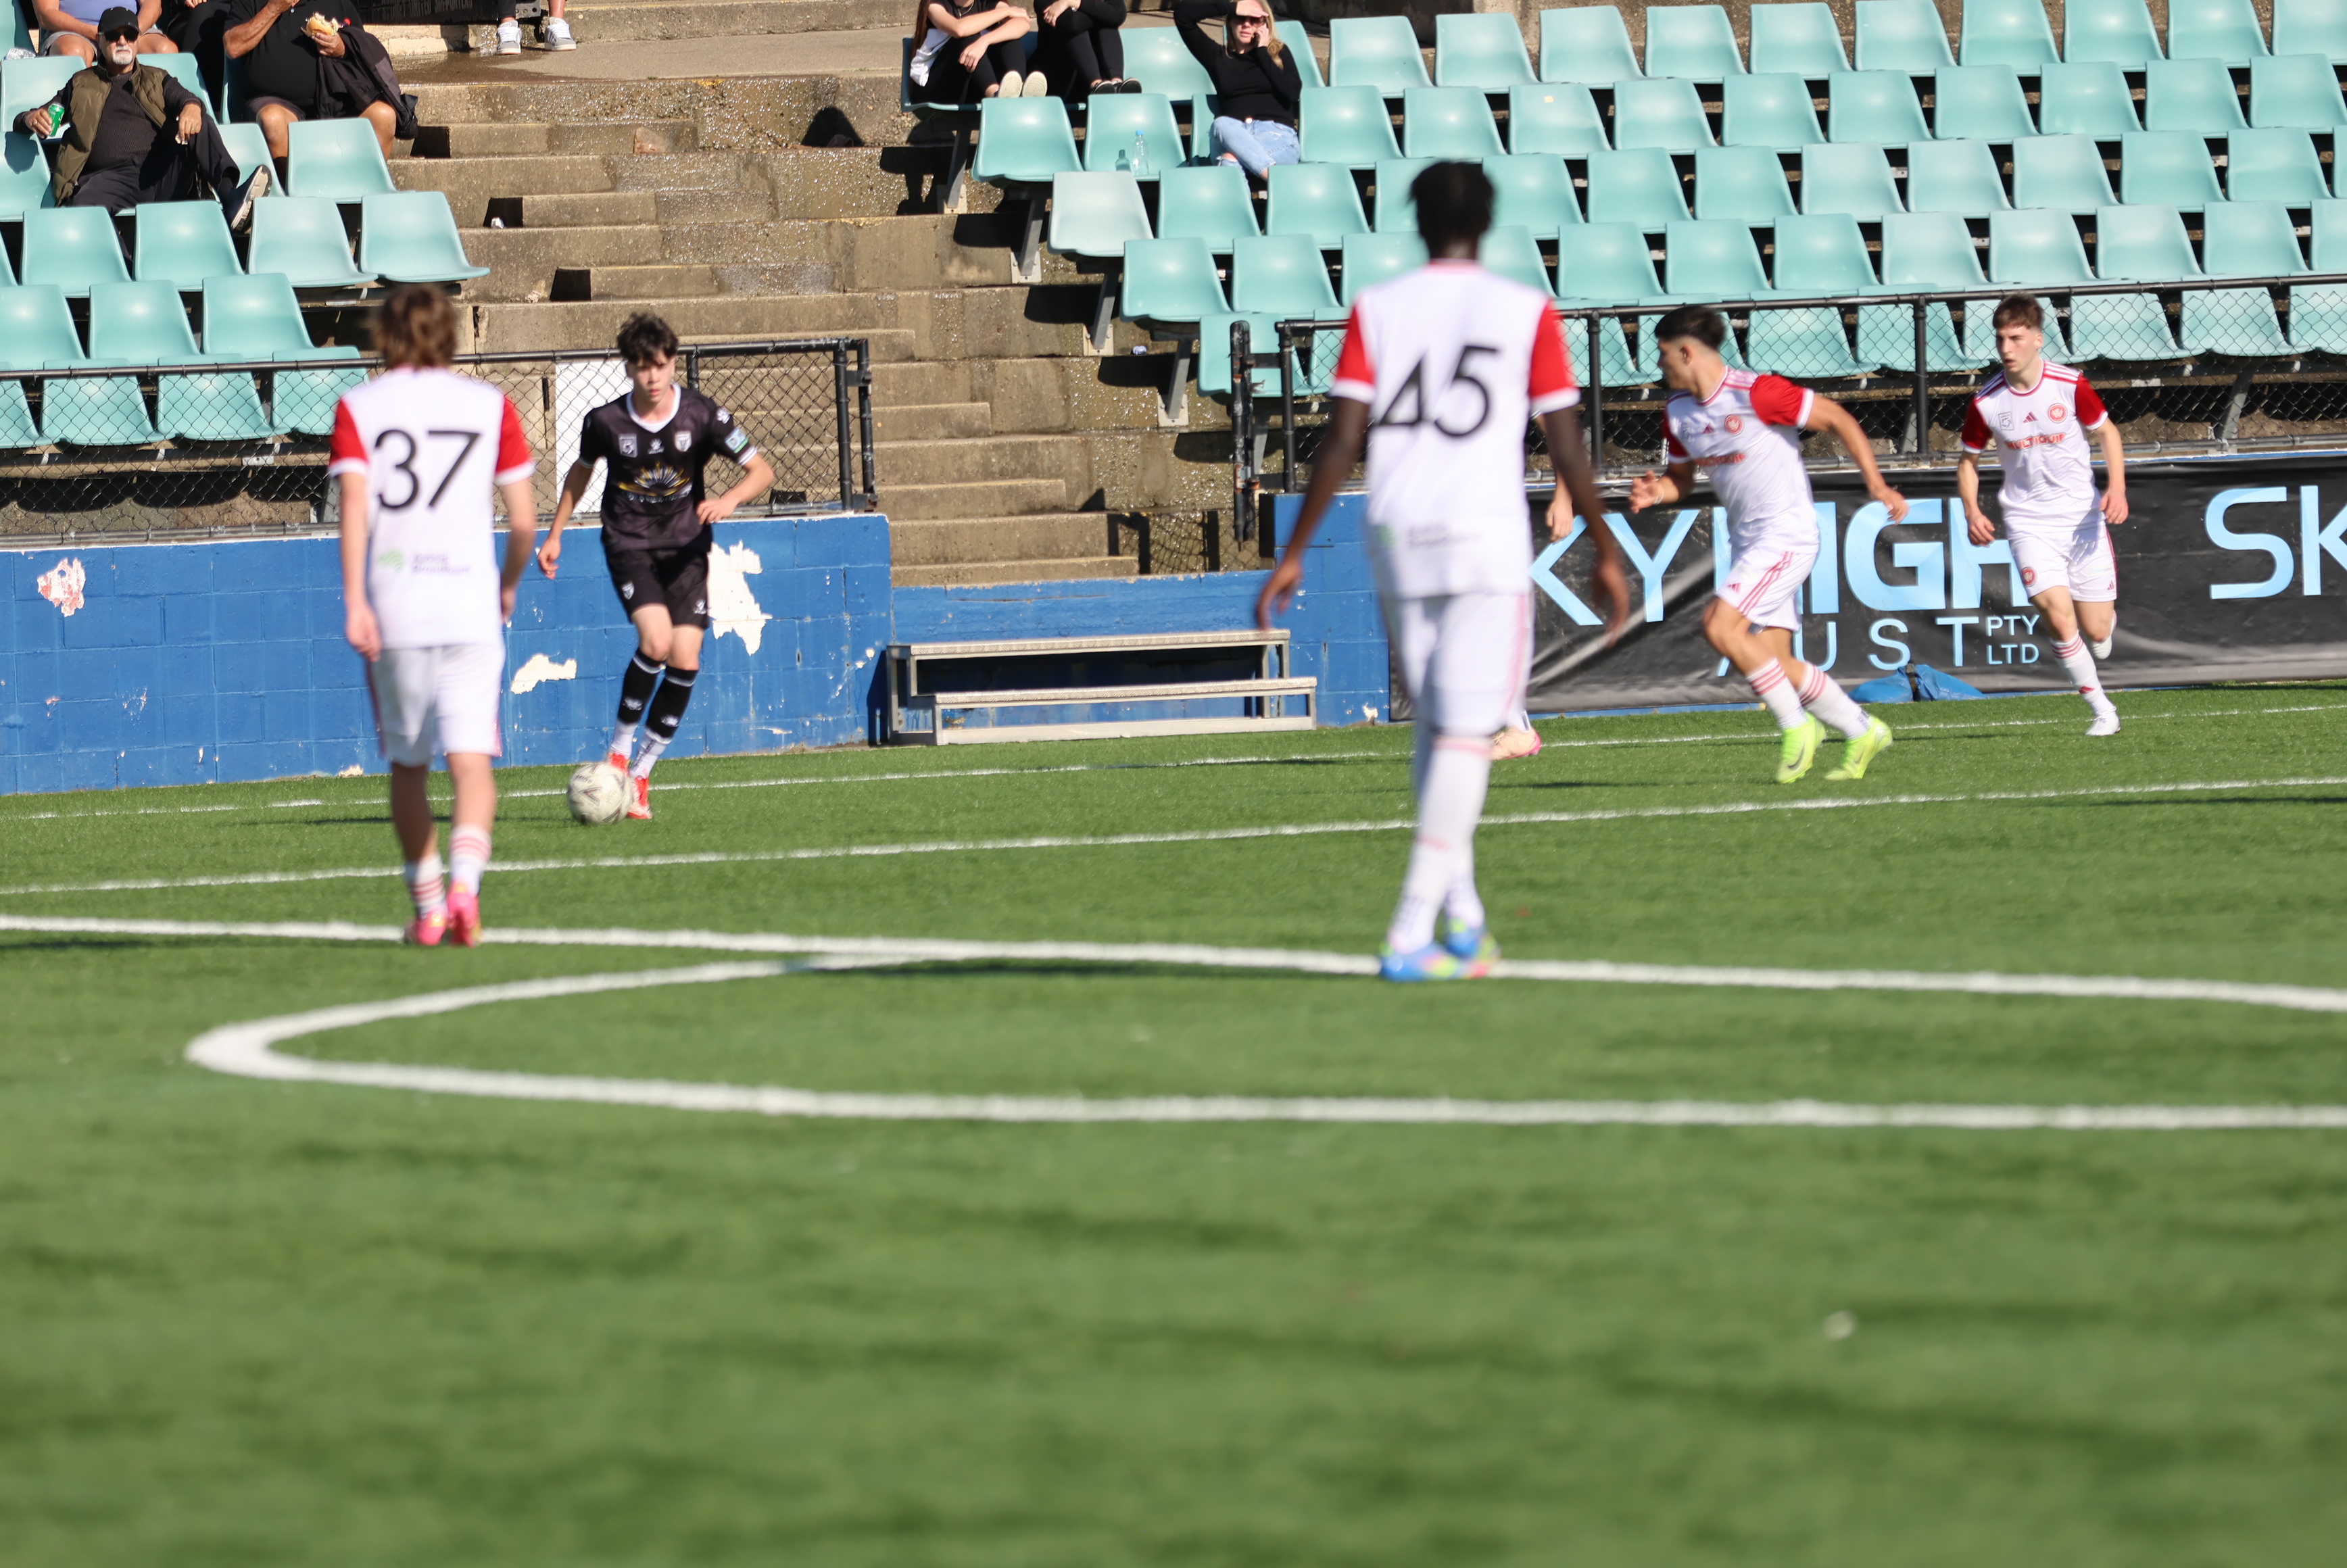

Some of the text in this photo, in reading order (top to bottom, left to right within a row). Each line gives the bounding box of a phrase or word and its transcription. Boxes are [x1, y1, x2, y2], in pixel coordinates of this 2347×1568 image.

[1378, 345, 1499, 437] 45
[374, 429, 482, 510] 37
[1717, 616, 1980, 677] UST
[1985, 614, 2040, 637] PTY
[1986, 643, 2040, 665] LTD
